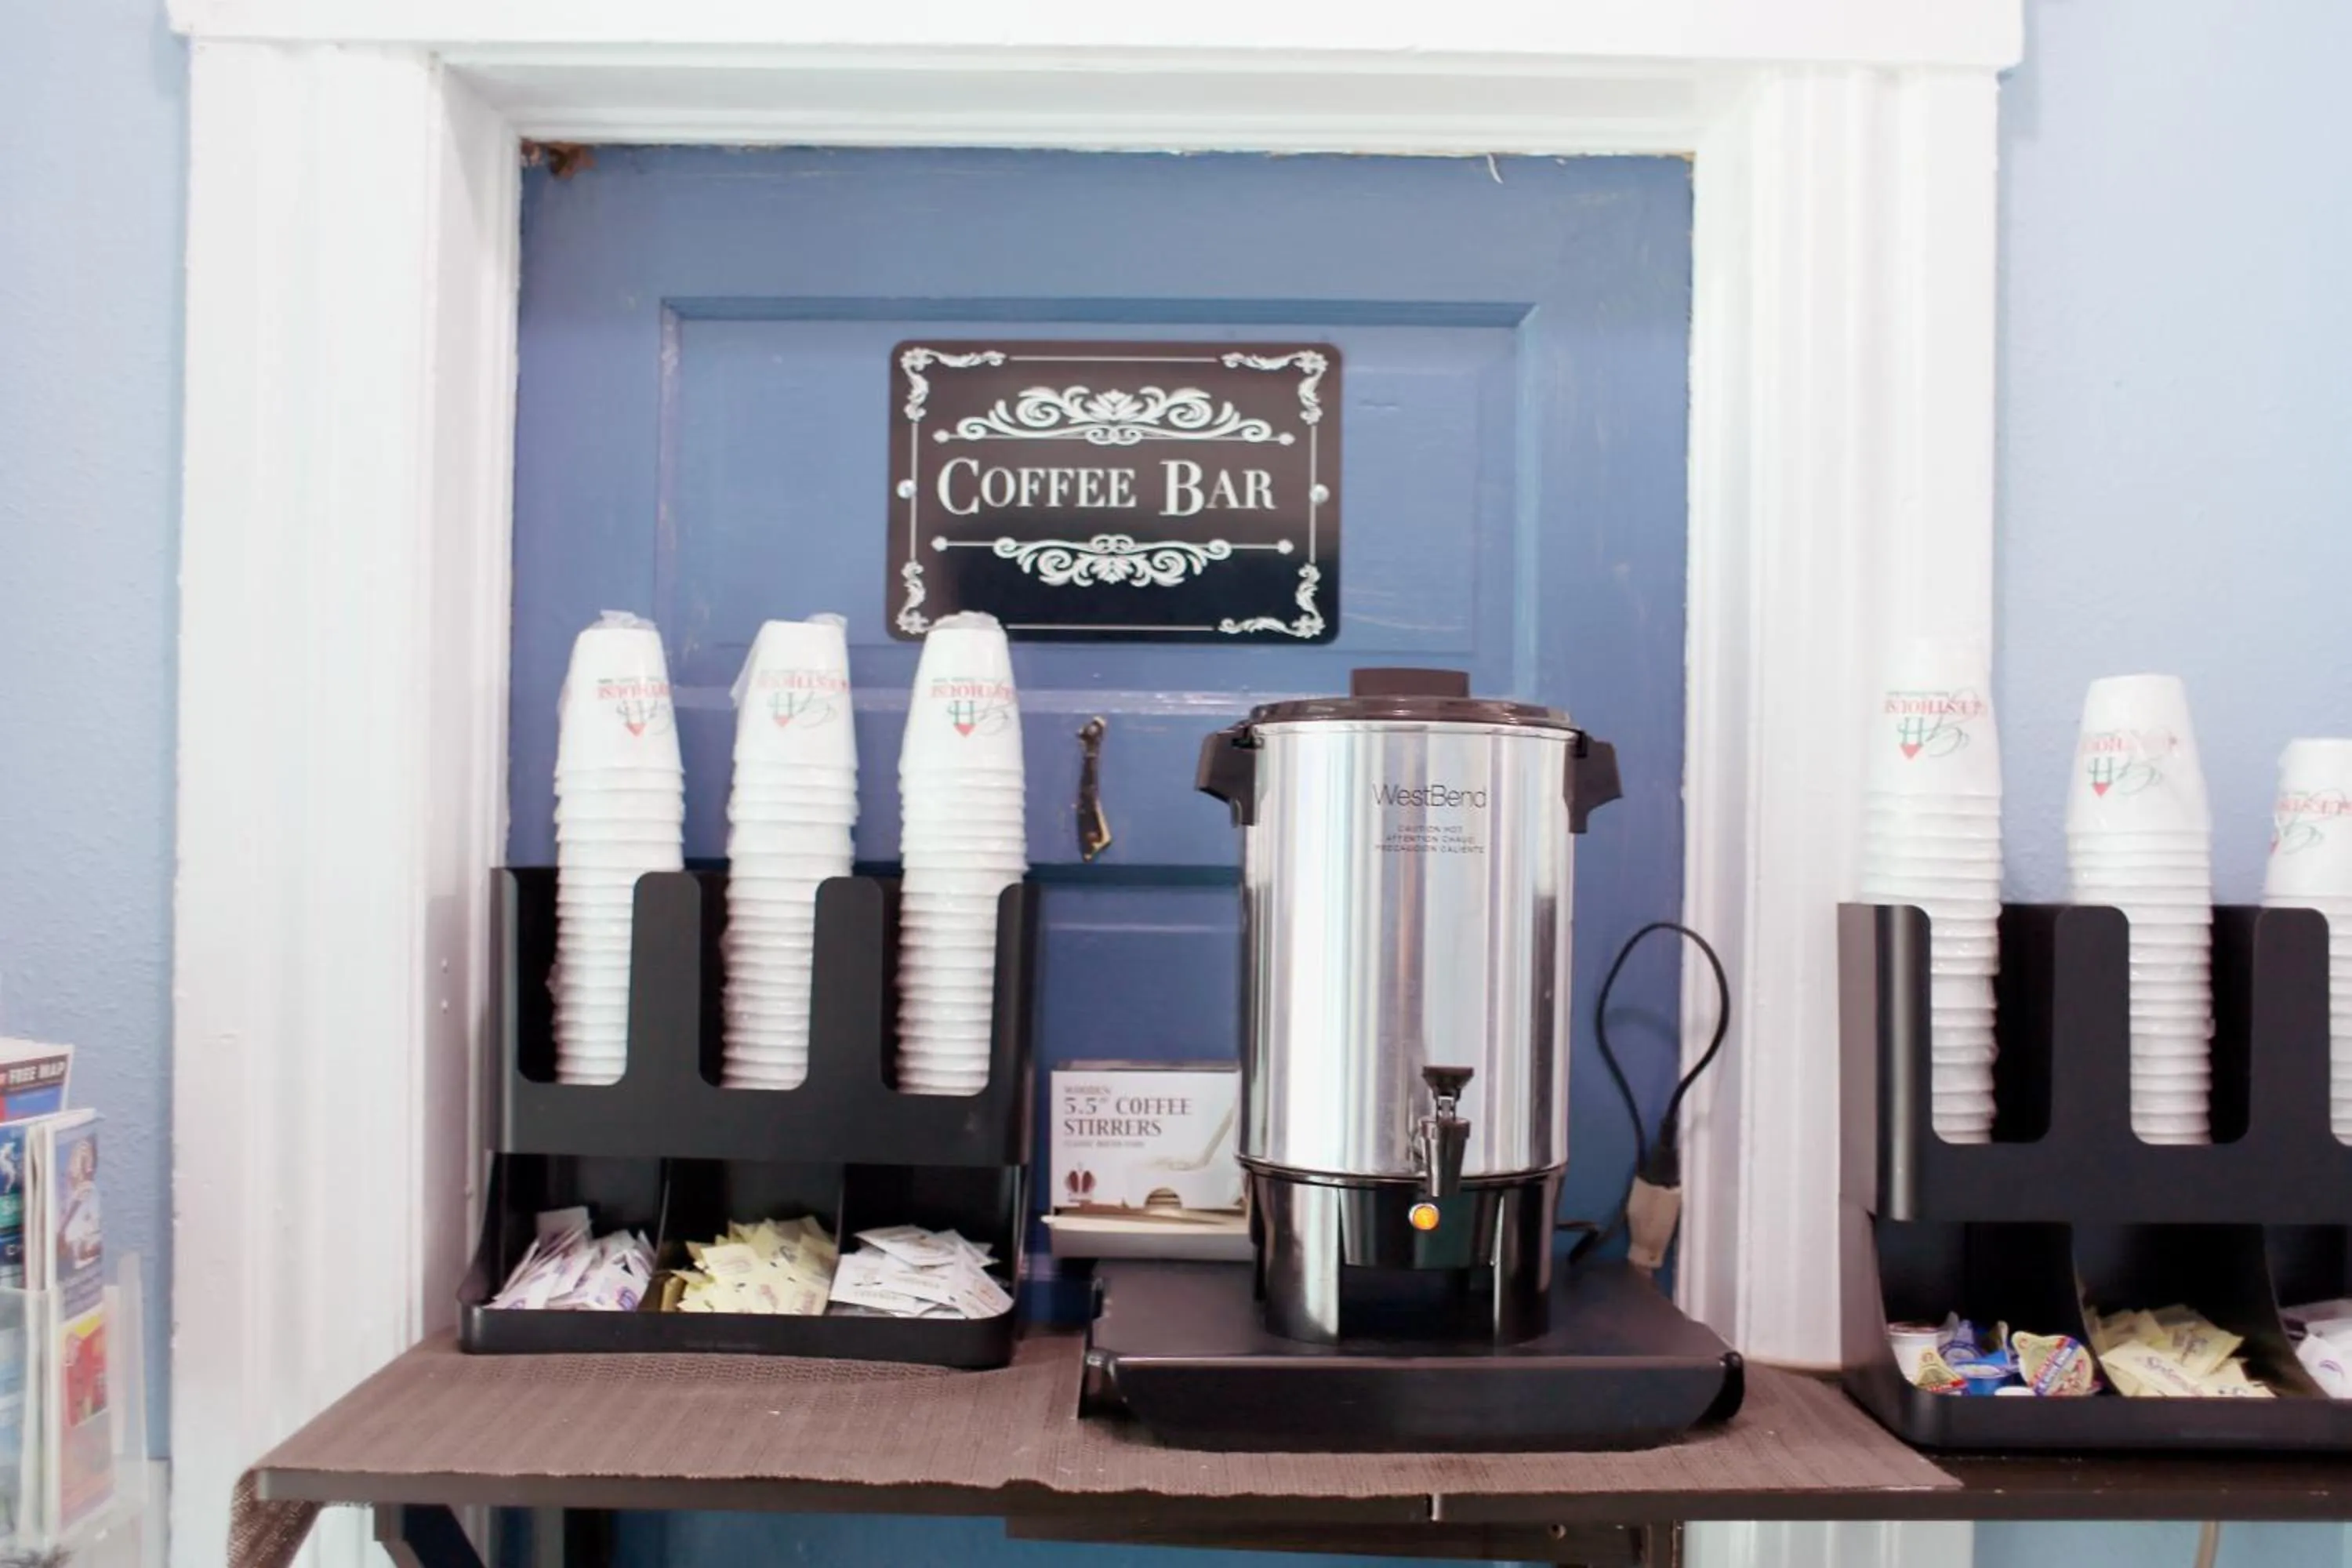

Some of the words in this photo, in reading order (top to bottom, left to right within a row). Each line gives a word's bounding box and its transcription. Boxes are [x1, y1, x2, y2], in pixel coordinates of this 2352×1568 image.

[937, 458, 1137, 514] COFFEE
[1159, 460, 1277, 516] BAR
[9, 1066, 38, 1085] FREE
[1115, 1097, 1193, 1116] COFFEE
[1063, 1119, 1162, 1137] STIRRERS
